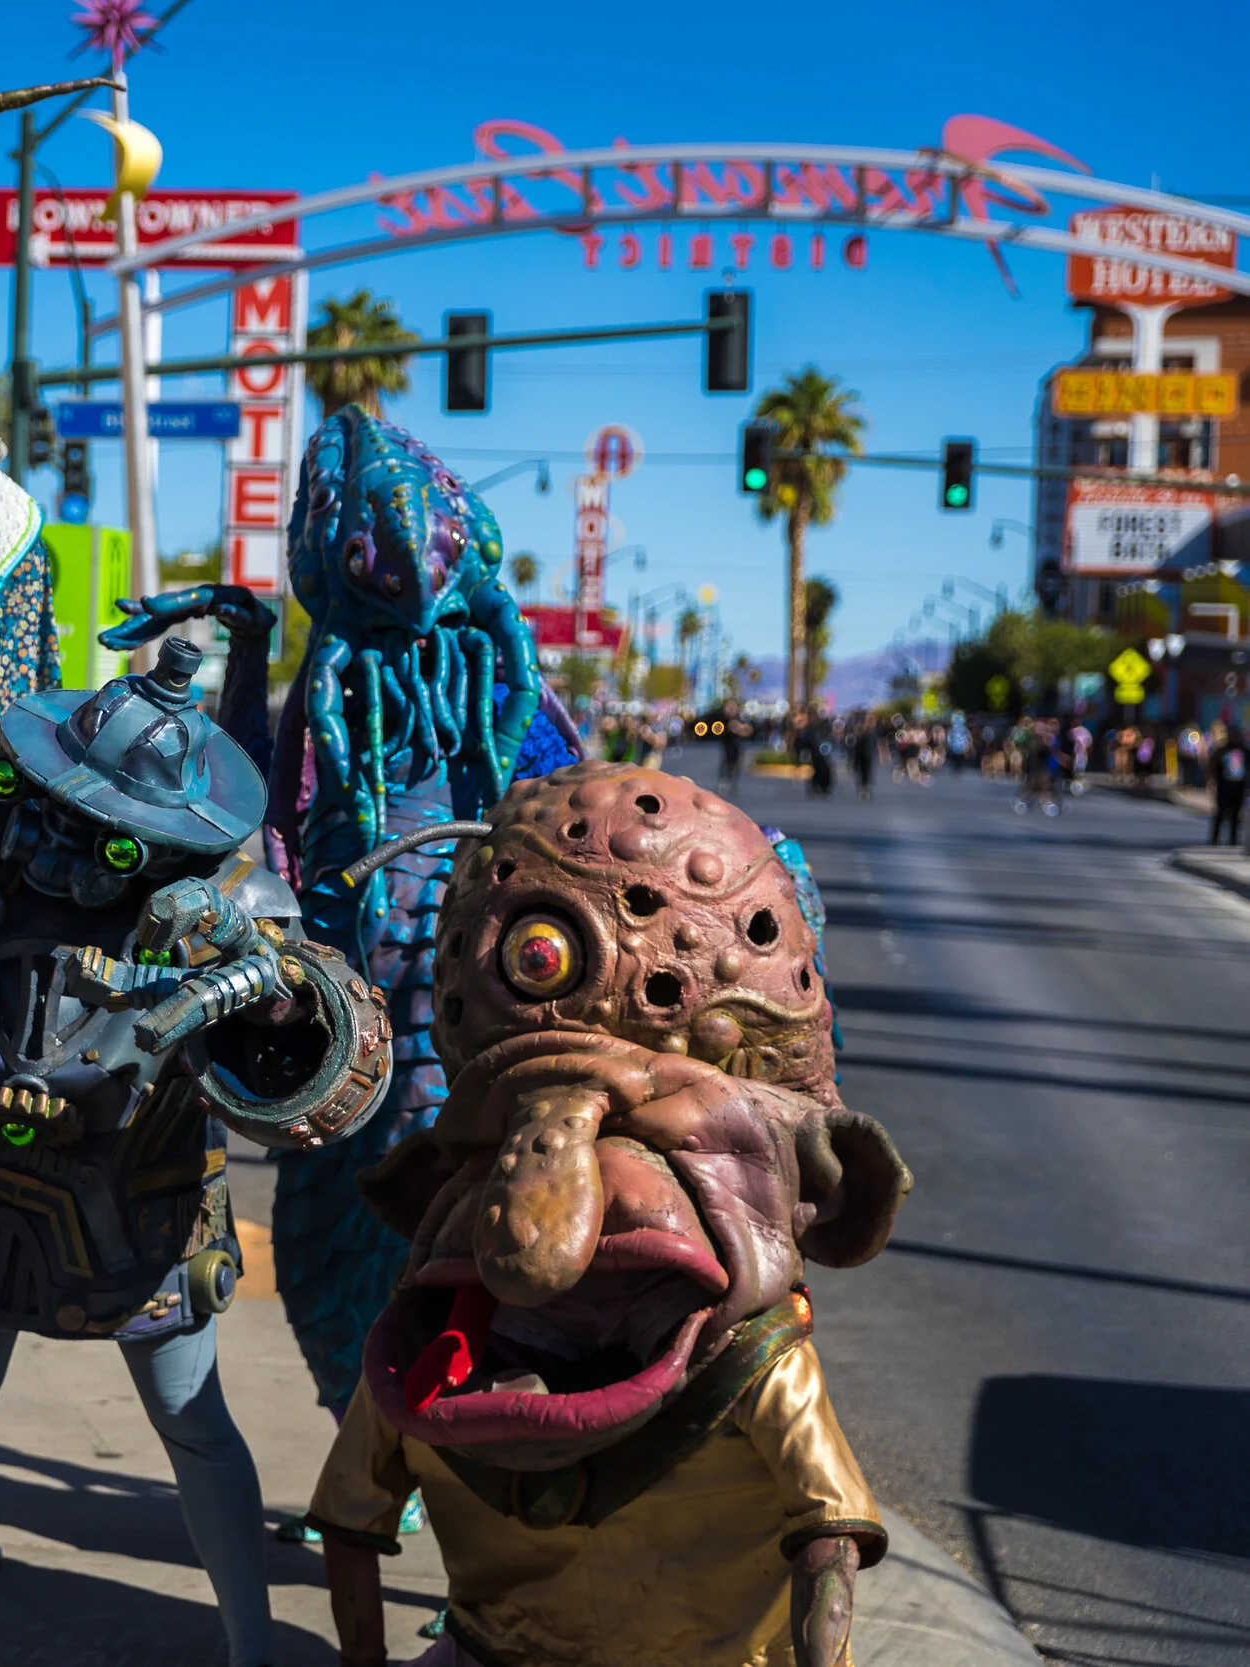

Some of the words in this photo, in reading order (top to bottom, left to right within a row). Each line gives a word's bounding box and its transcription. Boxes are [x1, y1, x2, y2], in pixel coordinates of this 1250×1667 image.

[6, 198, 274, 238] OWOWNER
[1072, 212, 1230, 252] WESTERN
[231, 272, 290, 594] MOTEL
